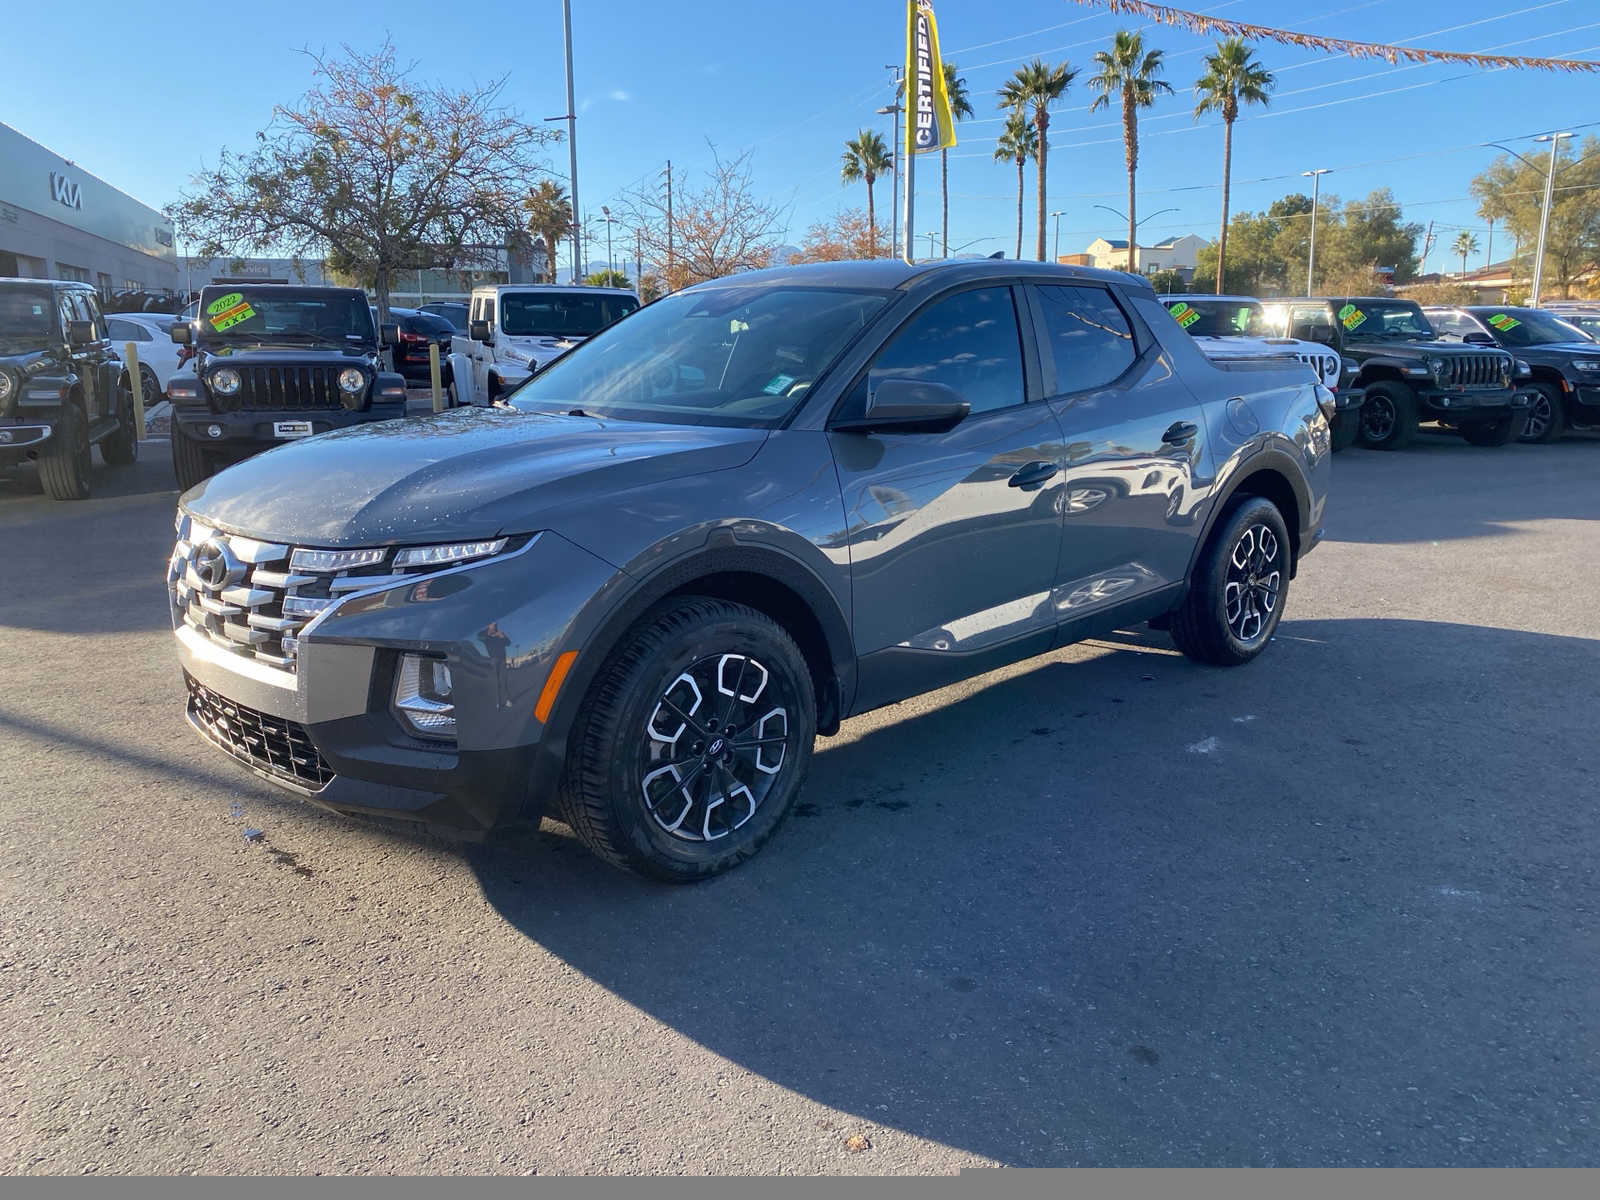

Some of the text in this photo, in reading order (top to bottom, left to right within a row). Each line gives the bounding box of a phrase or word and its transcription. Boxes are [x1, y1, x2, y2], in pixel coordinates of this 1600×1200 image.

[916, 16, 932, 145] CERTIFIED
[50, 172, 82, 208] KIA
[214, 295, 237, 312] 2022
